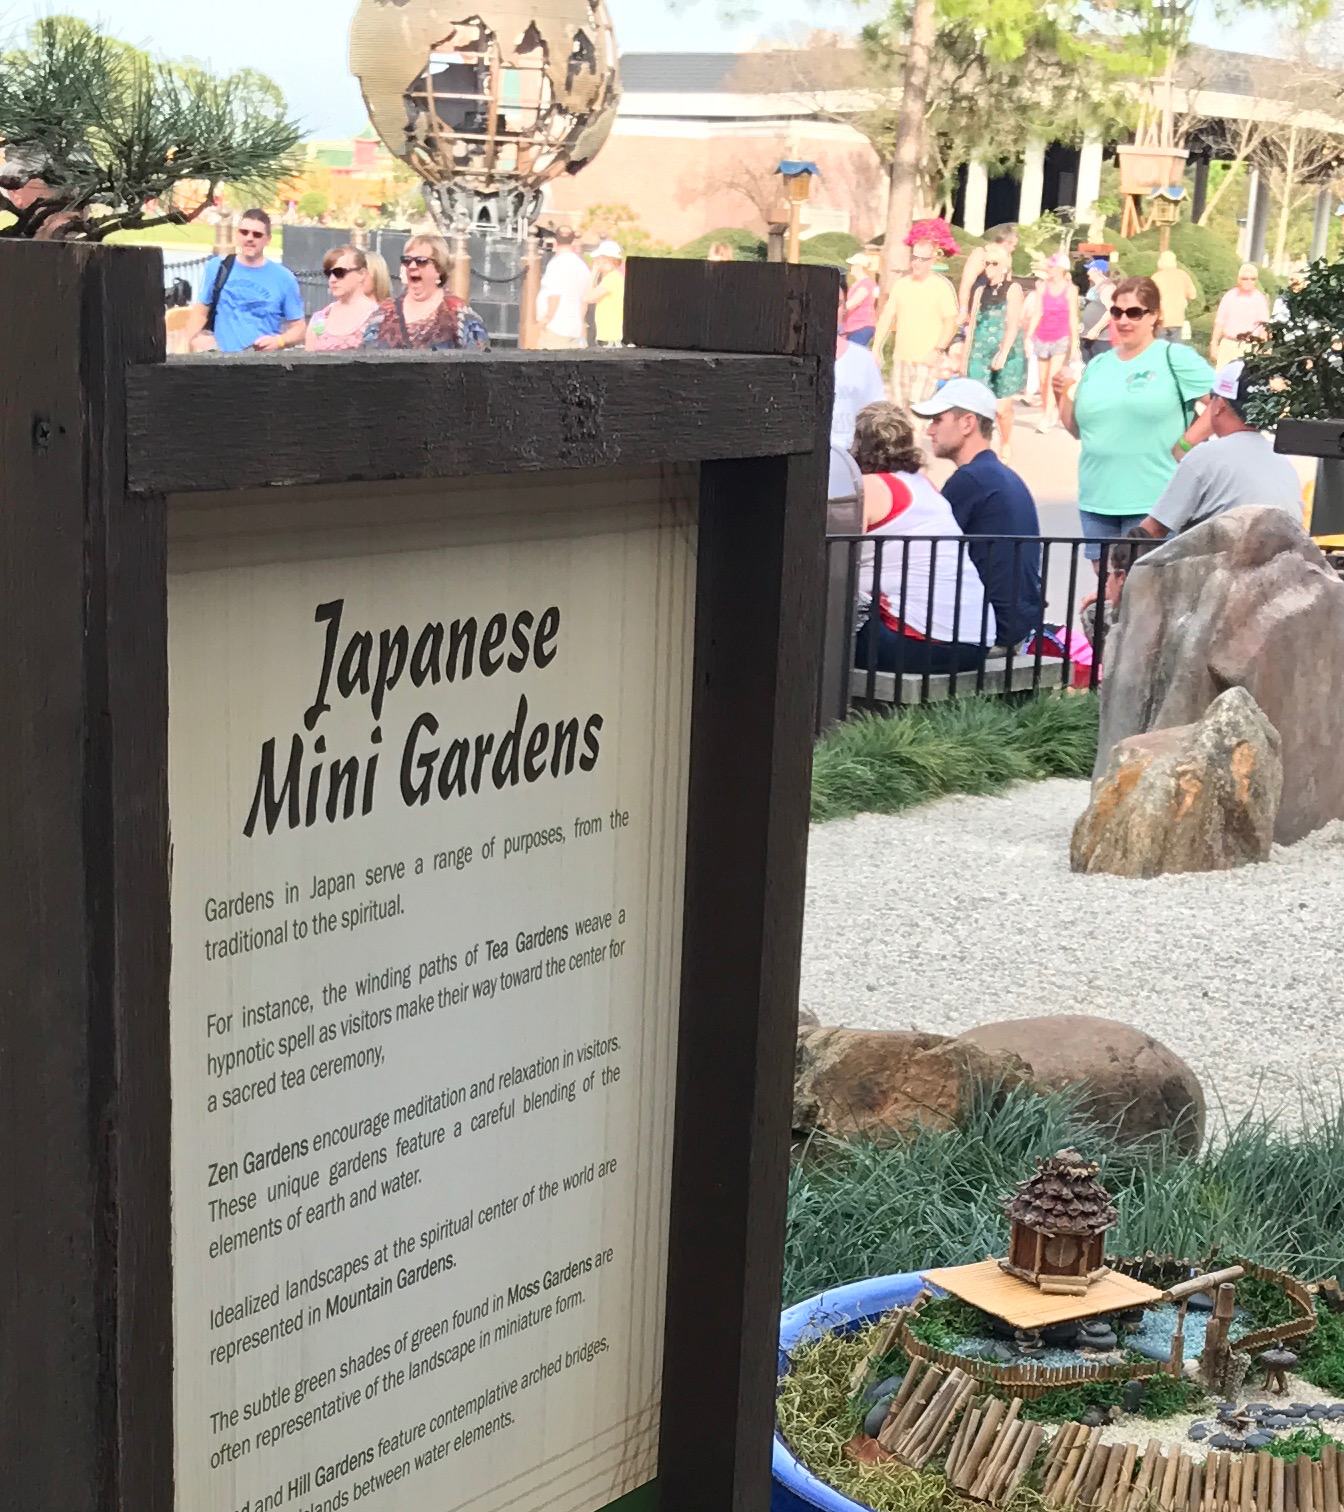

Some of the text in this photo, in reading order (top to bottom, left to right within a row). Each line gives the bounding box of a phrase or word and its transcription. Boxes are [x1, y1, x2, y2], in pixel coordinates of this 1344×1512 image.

[303, 598, 561, 732] Japanese
[242, 693, 604, 838] Mini Gardens
[205, 808, 629, 922] Gardens in Japan serve a range of purposes, from the
[205, 893, 404, 961] traditional to the spiritual.
[207, 909, 625, 1038] For instance, the winding paths of Tea Gardens weave a
[207, 938, 625, 1078] hypnotic spell as visitors make their way toward the center for
[207, 1045, 385, 1113] a sacred tea ceremony,
[208, 1037, 621, 1187] Zen Gardens encourage meditation and relaxation in visitors.
[208, 1066, 620, 1224] These unique gardens feature a careful blending of the
[209, 1169, 422, 1259] elements of earth and water.
[210, 1159, 617, 1330] Idealized landscapes at the spiritual center of the world are
[210, 1254, 456, 1365] represented in Mountain Gardens.
[210, 1248, 613, 1434] The subtle green shades of green found in Moss Gardens are
[211, 1291, 585, 1469] often representative of the landscape in miniature form.
[288, 1472, 310, 1501] Hill
[315, 1447, 374, 1487] Gardens
[378, 1423, 426, 1458] feature
[429, 1380, 518, 1433] contemplative
[521, 1354, 562, 1389] arched
[565, 1337, 609, 1368] bridges,
[353, 1461, 410, 1501] between
[414, 1441, 451, 1470] water
[454, 1412, 515, 1451] elements.
